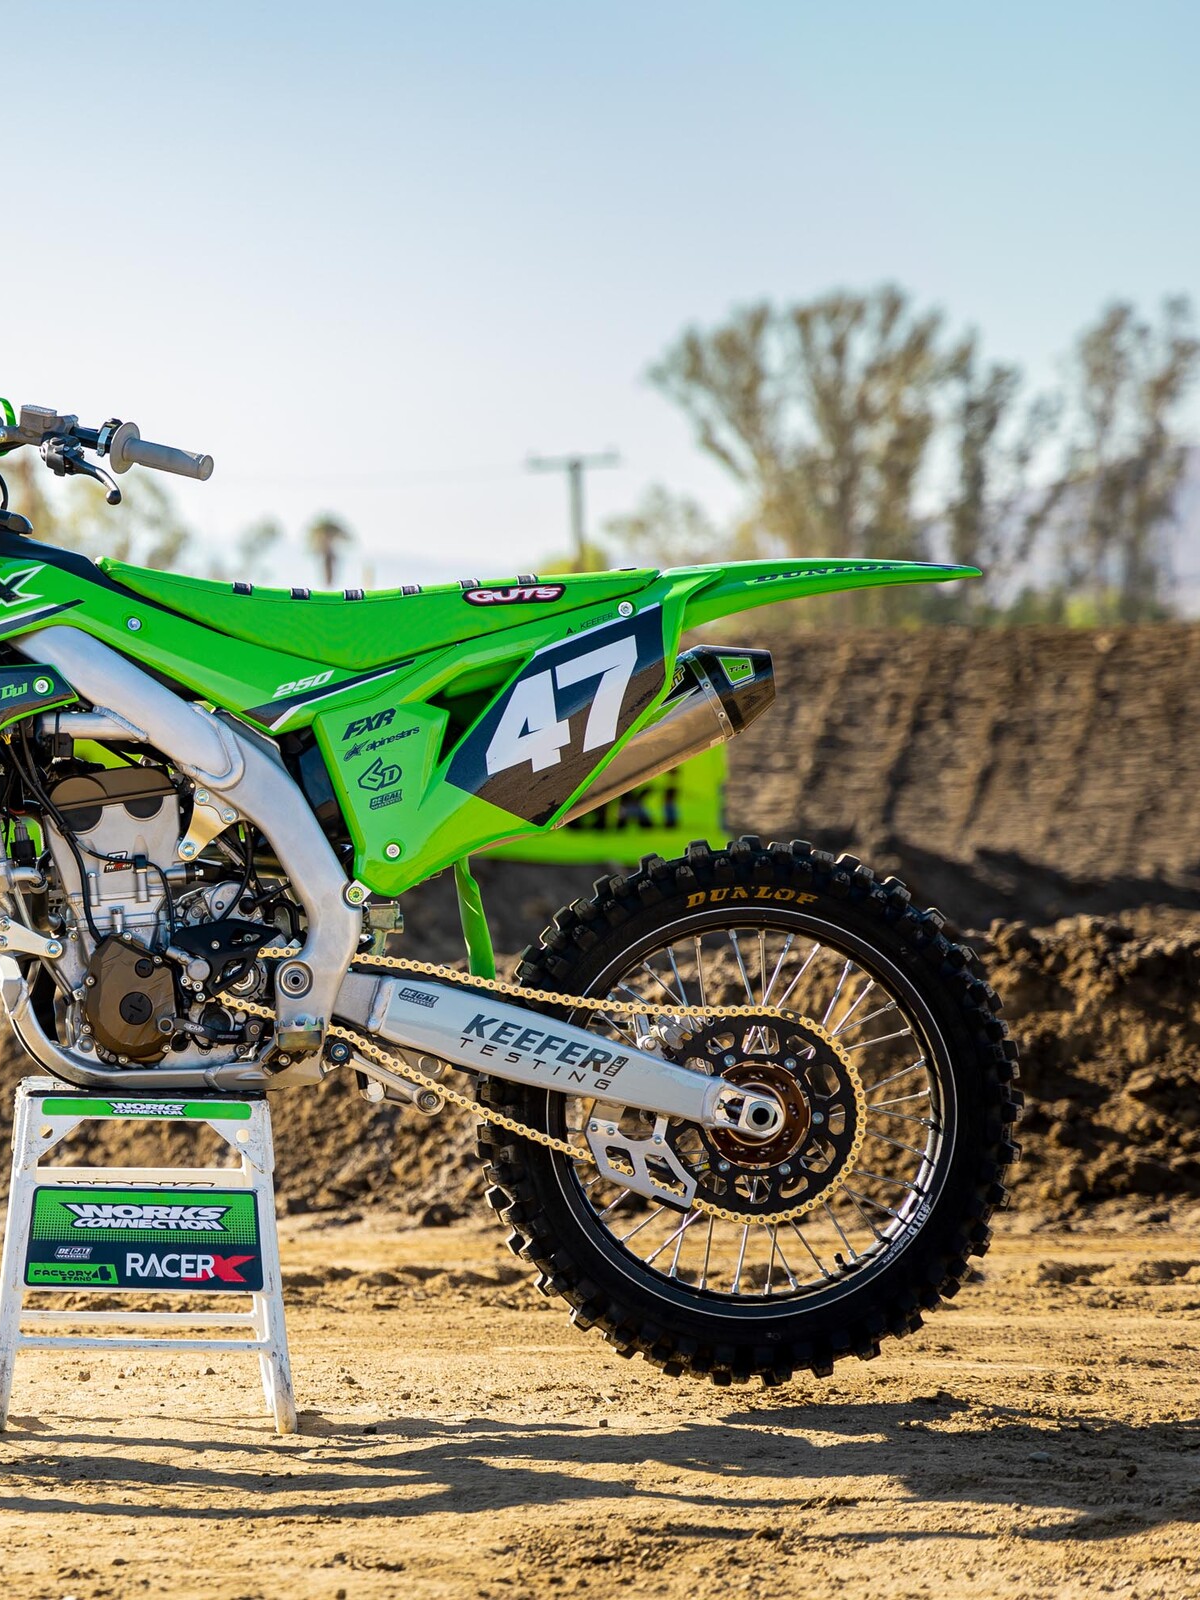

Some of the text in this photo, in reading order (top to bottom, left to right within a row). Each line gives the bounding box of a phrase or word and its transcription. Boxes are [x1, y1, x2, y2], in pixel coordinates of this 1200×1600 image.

[467, 586, 562, 603] GUTS
[580, 612, 614, 630] KEEFER
[272, 669, 335, 698] 250
[485, 635, 638, 774] 47
[341, 707, 397, 741] FXR
[365, 726, 420, 752] alpinestars
[371, 790, 402, 806] DECAL
[686, 885, 819, 908] DUNLOP
[400, 989, 438, 1004] DECAL
[462, 1013, 613, 1073] KEEFER
[460, 1037, 612, 1091] TESTING
[109, 1102, 186, 1111] WORKS
[65, 1203, 228, 1220] WORKS
[73, 1217, 225, 1231] CONNECTION
